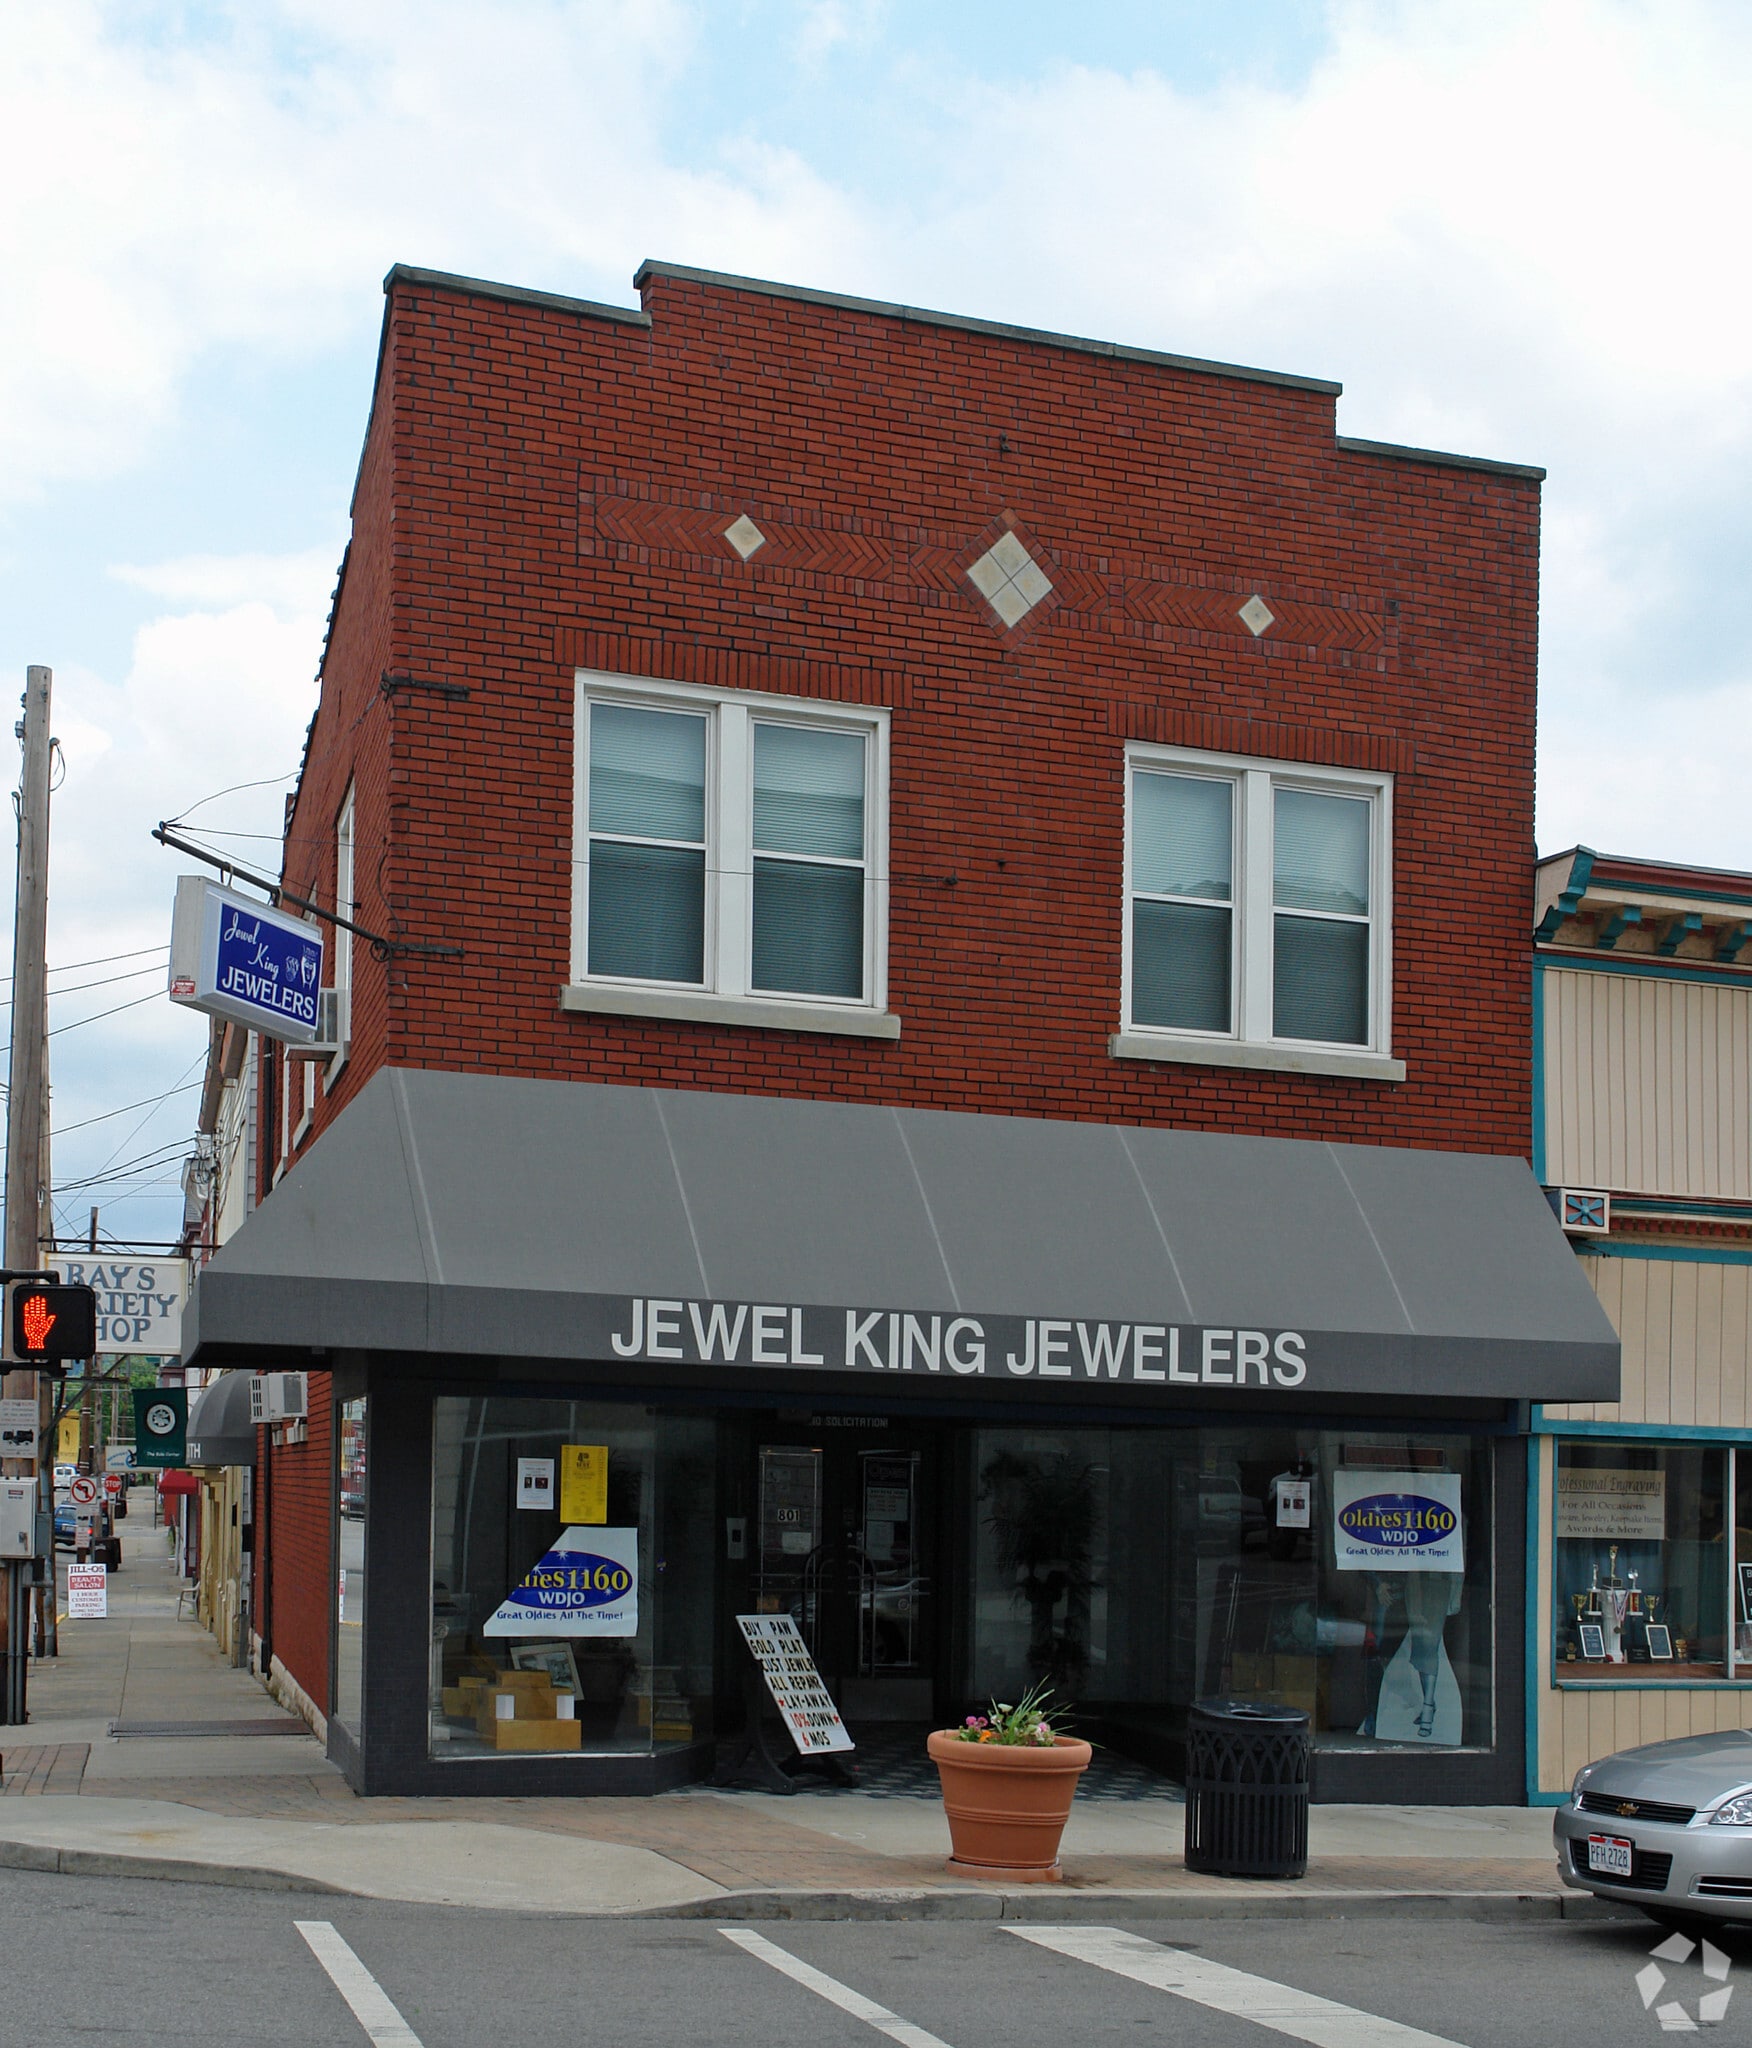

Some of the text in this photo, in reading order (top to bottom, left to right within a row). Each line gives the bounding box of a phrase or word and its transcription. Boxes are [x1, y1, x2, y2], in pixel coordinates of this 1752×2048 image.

[223, 912, 261, 945] Jewel
[247, 944, 280, 980] King
[221, 965, 314, 1020] JEWELERS
[95, 1316, 152, 1343] HOP
[611, 1298, 1307, 1387] JEWEL KING JEWELERS
[105, 1480, 121, 1488] STOP
[1609, 1477, 1661, 1496] Engraving
[1581, 1500, 1596, 1509] All
[1598, 1500, 1647, 1510] Occasions
[779, 1509, 799, 1521] 801
[1565, 1524, 1644, 1534] Awards & More
[1381, 1530, 1419, 1545] WDJO
[1346, 1547, 1368, 1556] Great
[1370, 1547, 1395, 1557] Oldies
[1412, 1548, 1426, 1557] The
[1428, 1548, 1450, 1557] Time!
[538, 1591, 585, 1607] WDJO
[497, 1611, 523, 1620] Great
[525, 1611, 556, 1620] Oldies
[577, 1611, 593, 1620] The
[597, 1611, 623, 1621] Time!
[742, 1621, 792, 1636] BUY PAW
[750, 1639, 804, 1654] GOLD PLAT
[769, 1676, 788, 1691] ALL
[783, 1694, 832, 1709] LAY-AWAY
[801, 1730, 830, 1747] 6 MOS
[1591, 1844, 1628, 1868] PFH 2728
